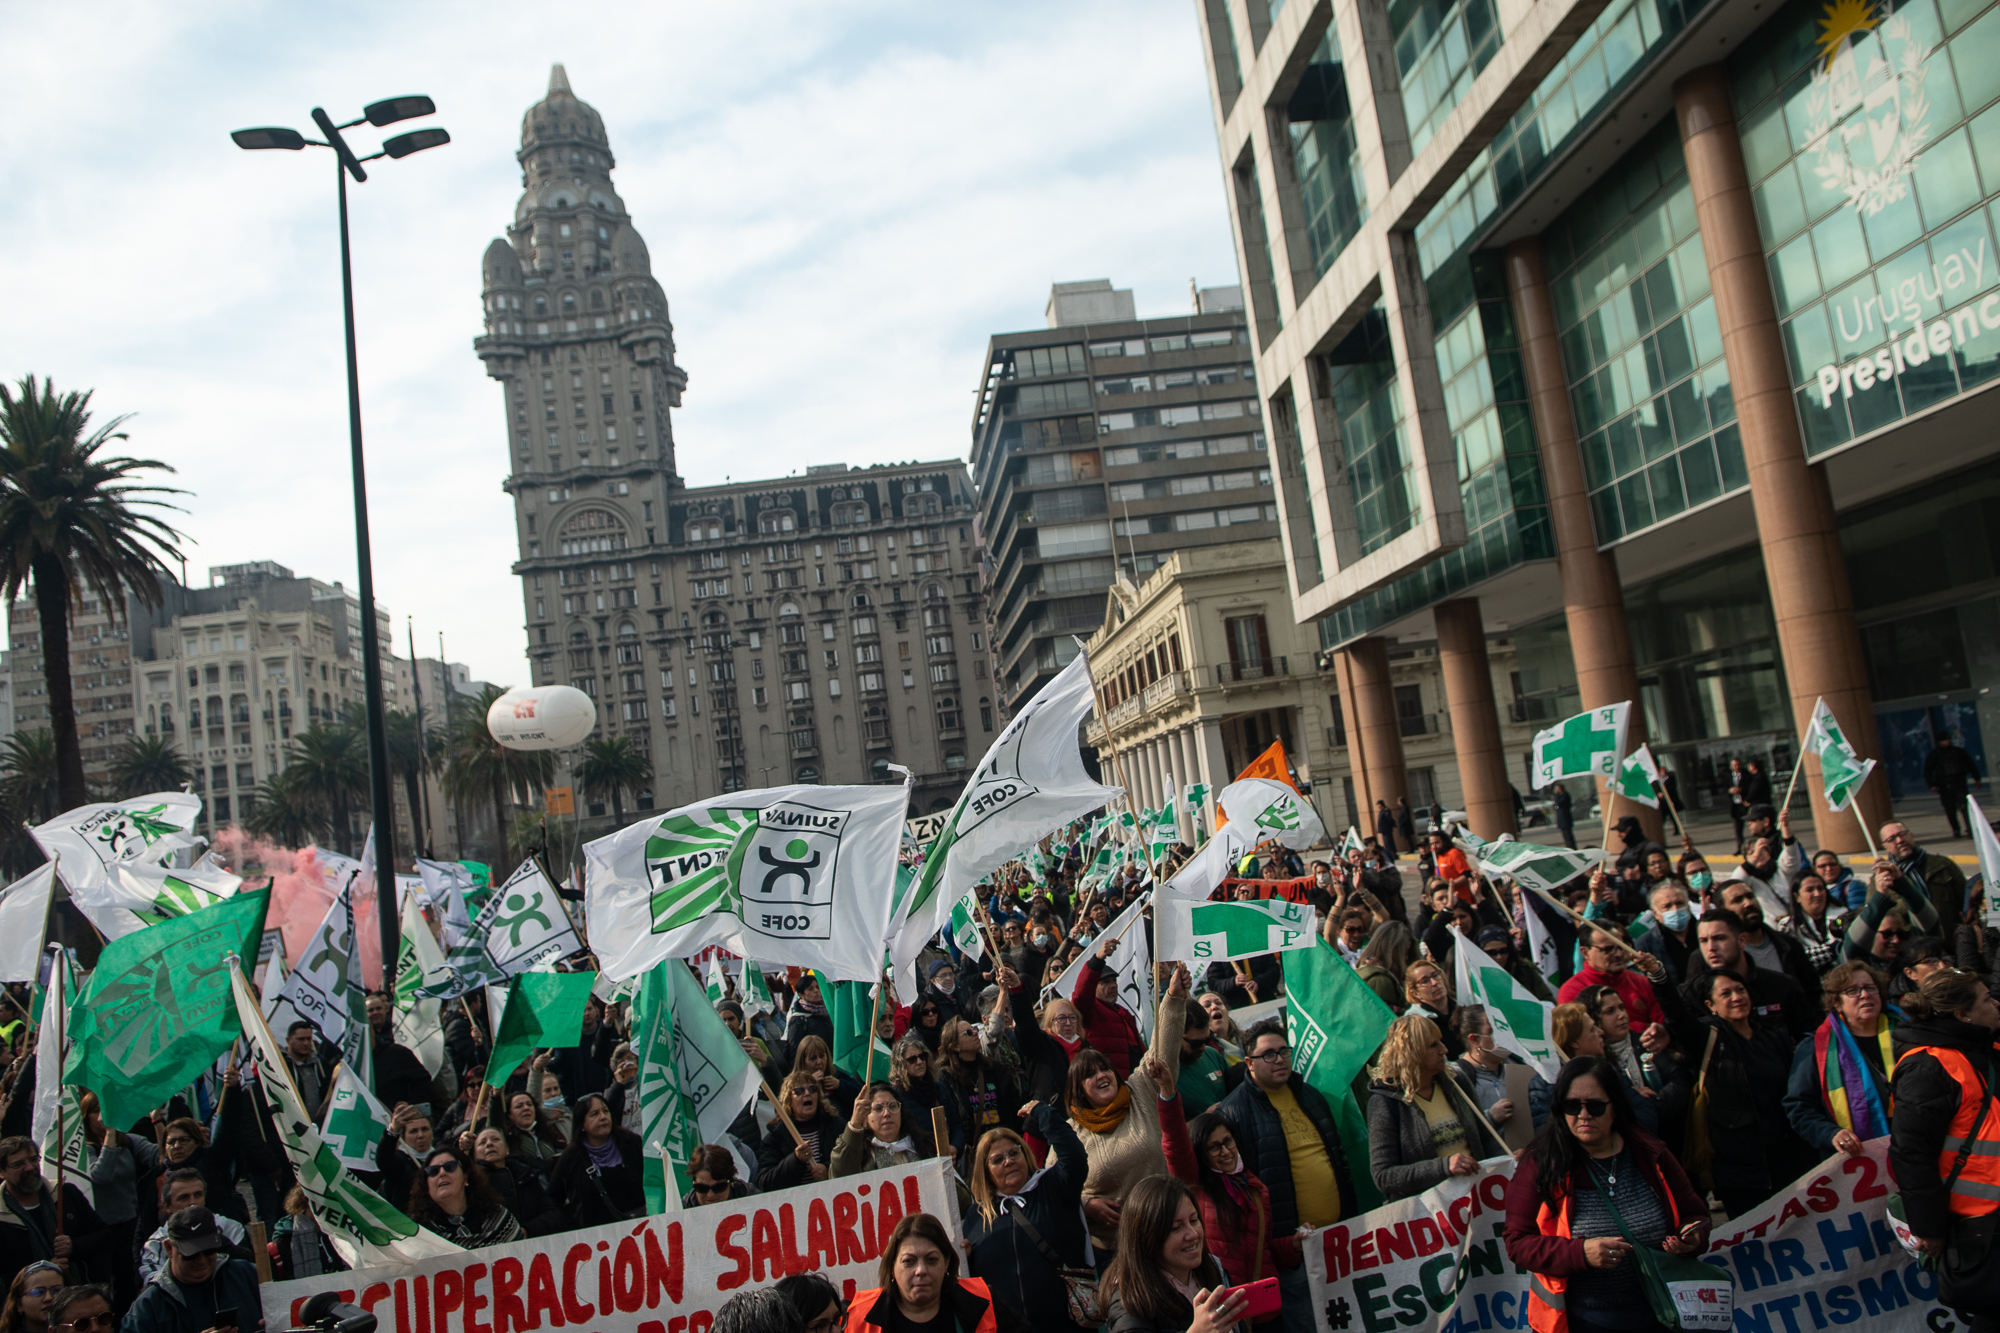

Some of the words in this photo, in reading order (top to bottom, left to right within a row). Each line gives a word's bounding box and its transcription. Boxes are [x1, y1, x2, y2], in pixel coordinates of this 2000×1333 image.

[1836, 237, 1985, 342] Uruguay
[183, 930, 222, 951] COFE
[961, 930, 977, 948] P
[1194, 941, 1213, 958] S
[1281, 930, 1300, 947] P
[1843, 1156, 1899, 1204] 2
[309, 1200, 365, 1248] VERA
